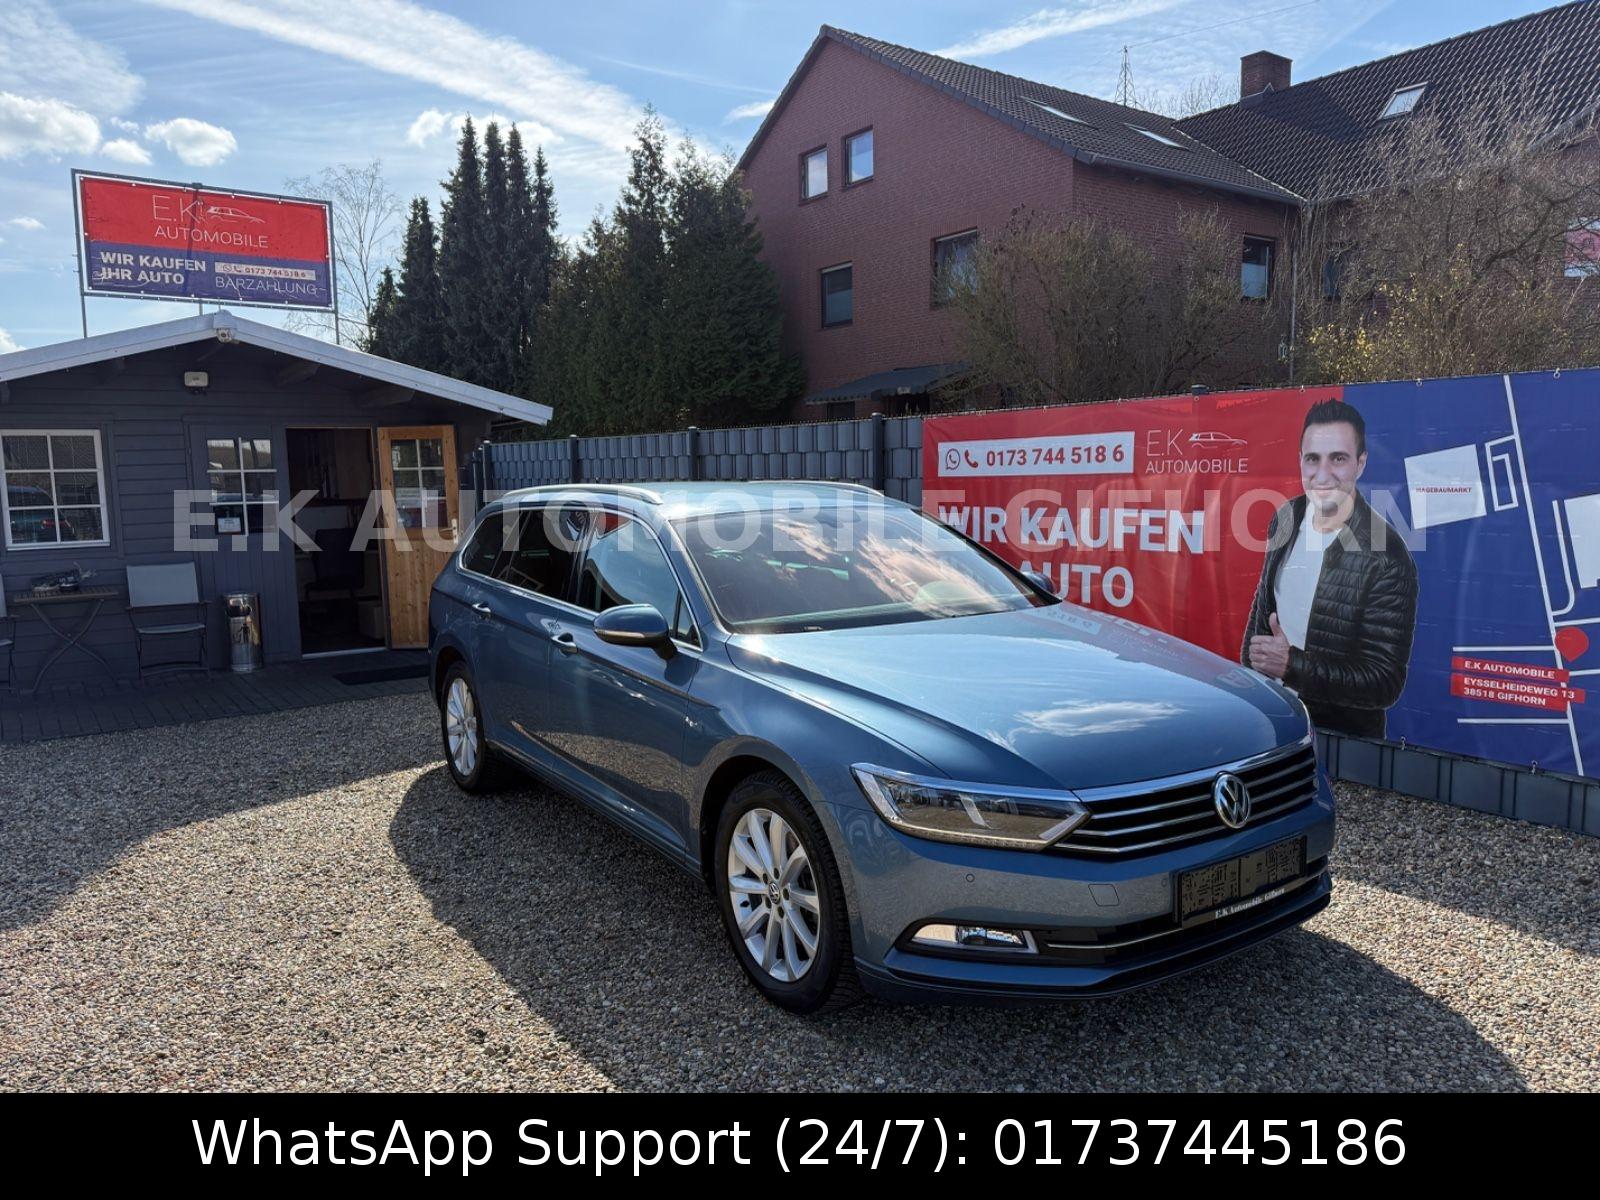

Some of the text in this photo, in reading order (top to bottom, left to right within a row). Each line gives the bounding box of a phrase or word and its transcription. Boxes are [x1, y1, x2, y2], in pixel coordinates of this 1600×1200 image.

[152, 194, 201, 224] E.K
[154, 225, 269, 249] AUTOMOBILE
[100, 251, 207, 272] WIR KAUFEN
[244, 266, 265, 276] 0173
[101, 267, 185, 285] IHR AUTO
[215, 276, 318, 295] BARZAHLUNG
[1146, 429, 1184, 457] E.K
[986, 444, 1125, 467] 0173 744 518 6
[1145, 457, 1249, 475] AUTOMOBILE
[938, 505, 1205, 554] WIR KAUFEN
[1464, 660, 1555, 680] E.K AUTOMOBILE
[1464, 677, 1575, 699] EYSSELHEIDEWEG 13
[1464, 687, 1546, 706] 38518 GIFHORN
